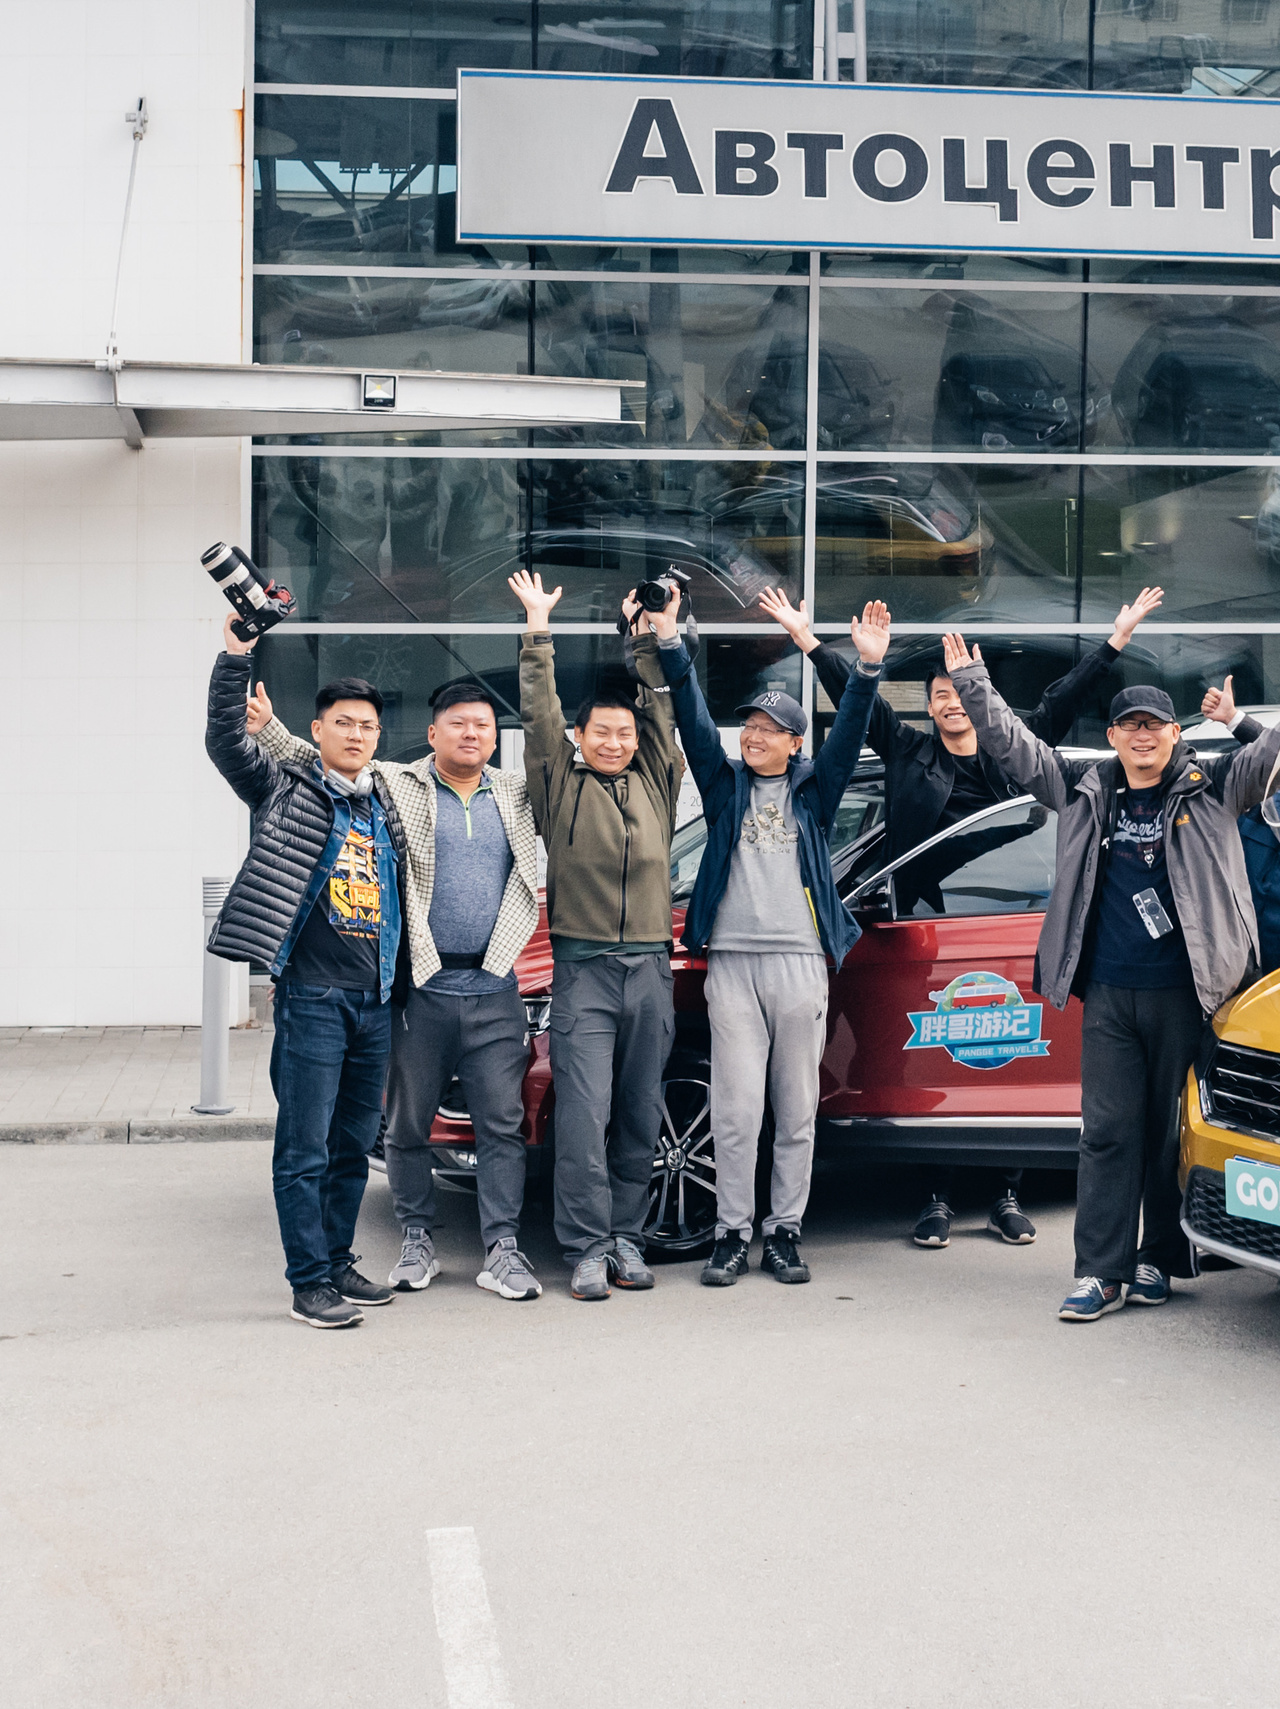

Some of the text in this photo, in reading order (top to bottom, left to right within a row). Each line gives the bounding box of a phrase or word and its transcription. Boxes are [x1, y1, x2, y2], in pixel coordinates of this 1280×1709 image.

[919, 1009, 1030, 1042] 胖哥游记
[958, 1044, 1039, 1057] PANGGE TRAVELS
